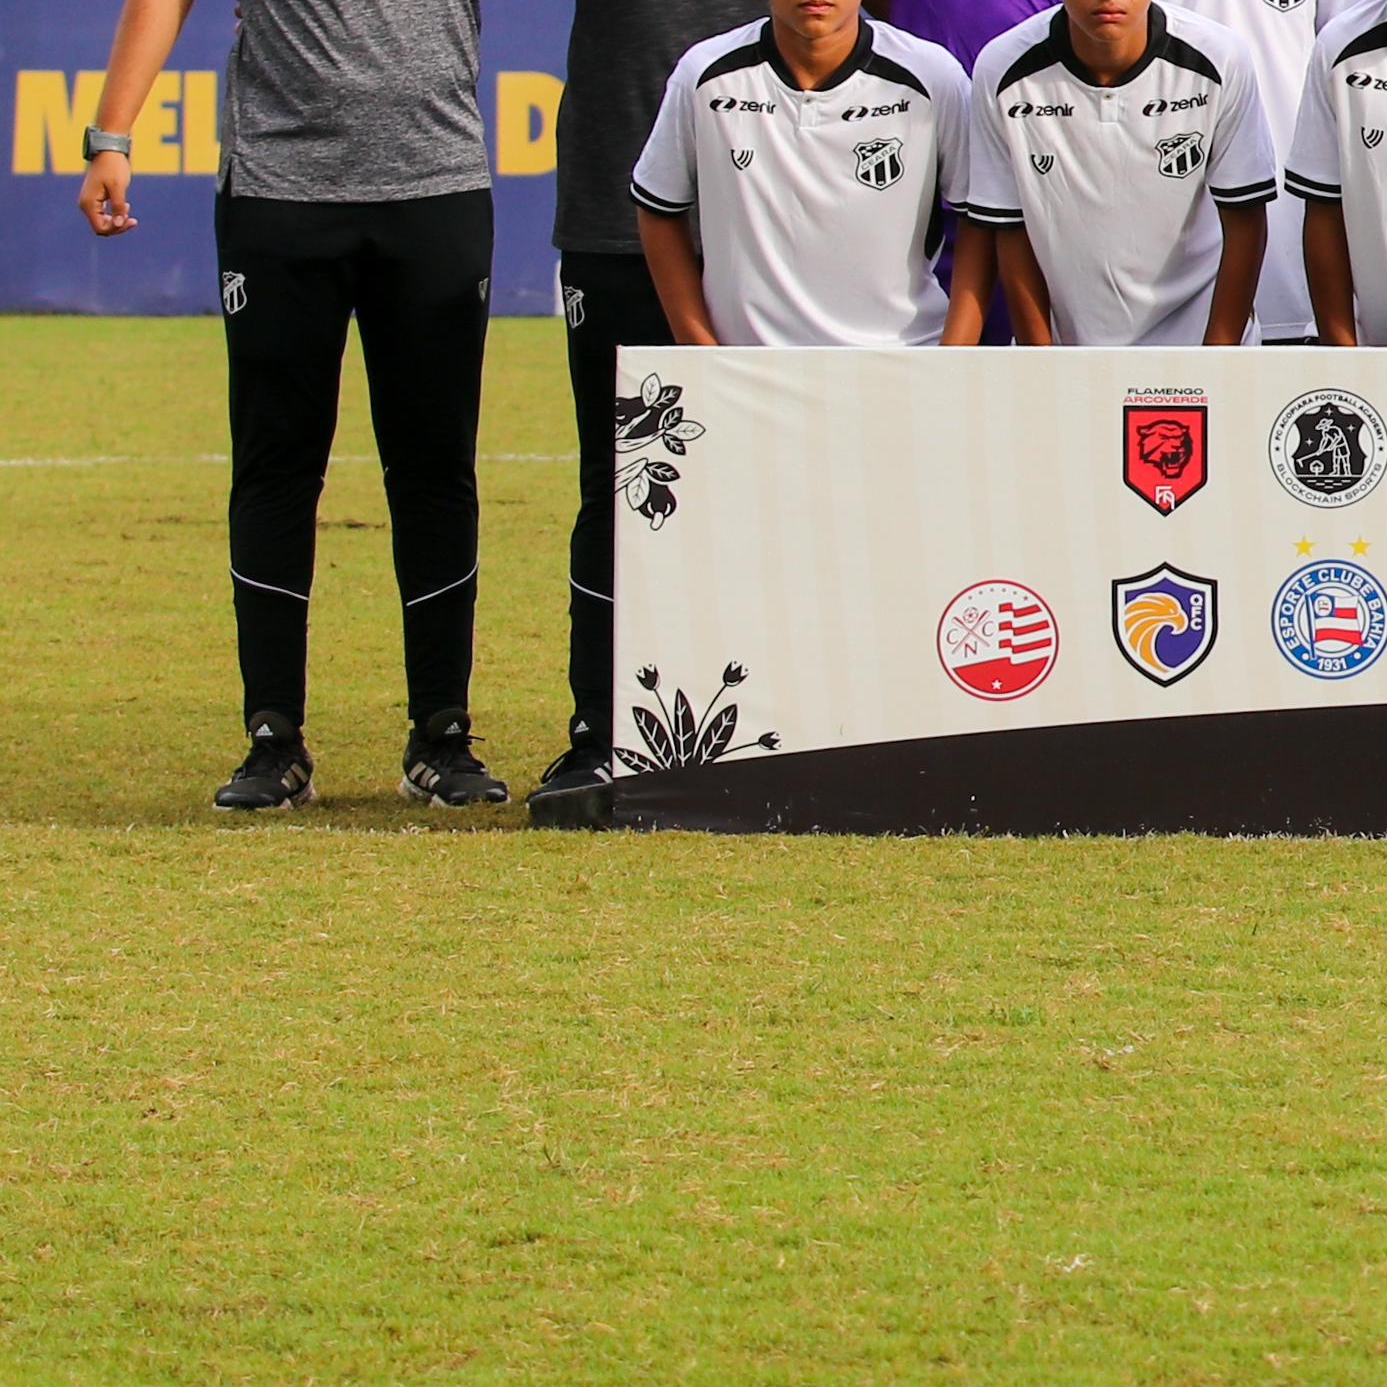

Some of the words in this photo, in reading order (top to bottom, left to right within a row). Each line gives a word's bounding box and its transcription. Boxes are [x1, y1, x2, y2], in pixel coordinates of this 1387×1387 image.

[738, 99, 777, 115] zenir
[870, 98, 911, 118] zenir
[1035, 102, 1075, 118] zenir
[1169, 93, 1209, 112] zenir
[1123, 396, 1208, 404] ARCOVERDE
[1127, 388, 1204, 396] FLAMENGO
[1314, 394, 1358, 407] FOOTBALL
[1359, 405, 1384, 441] ACADEMY
[1277, 463, 1342, 503] BLOCKCHAIN
[1345, 463, 1382, 501] SPORTS
[1280, 574, 1316, 650] ESPORTE
[1318, 569, 1374, 597] CLUBE
[1362, 598, 1385, 649] BAHIA
[1317, 657, 1348, 672] 1931
